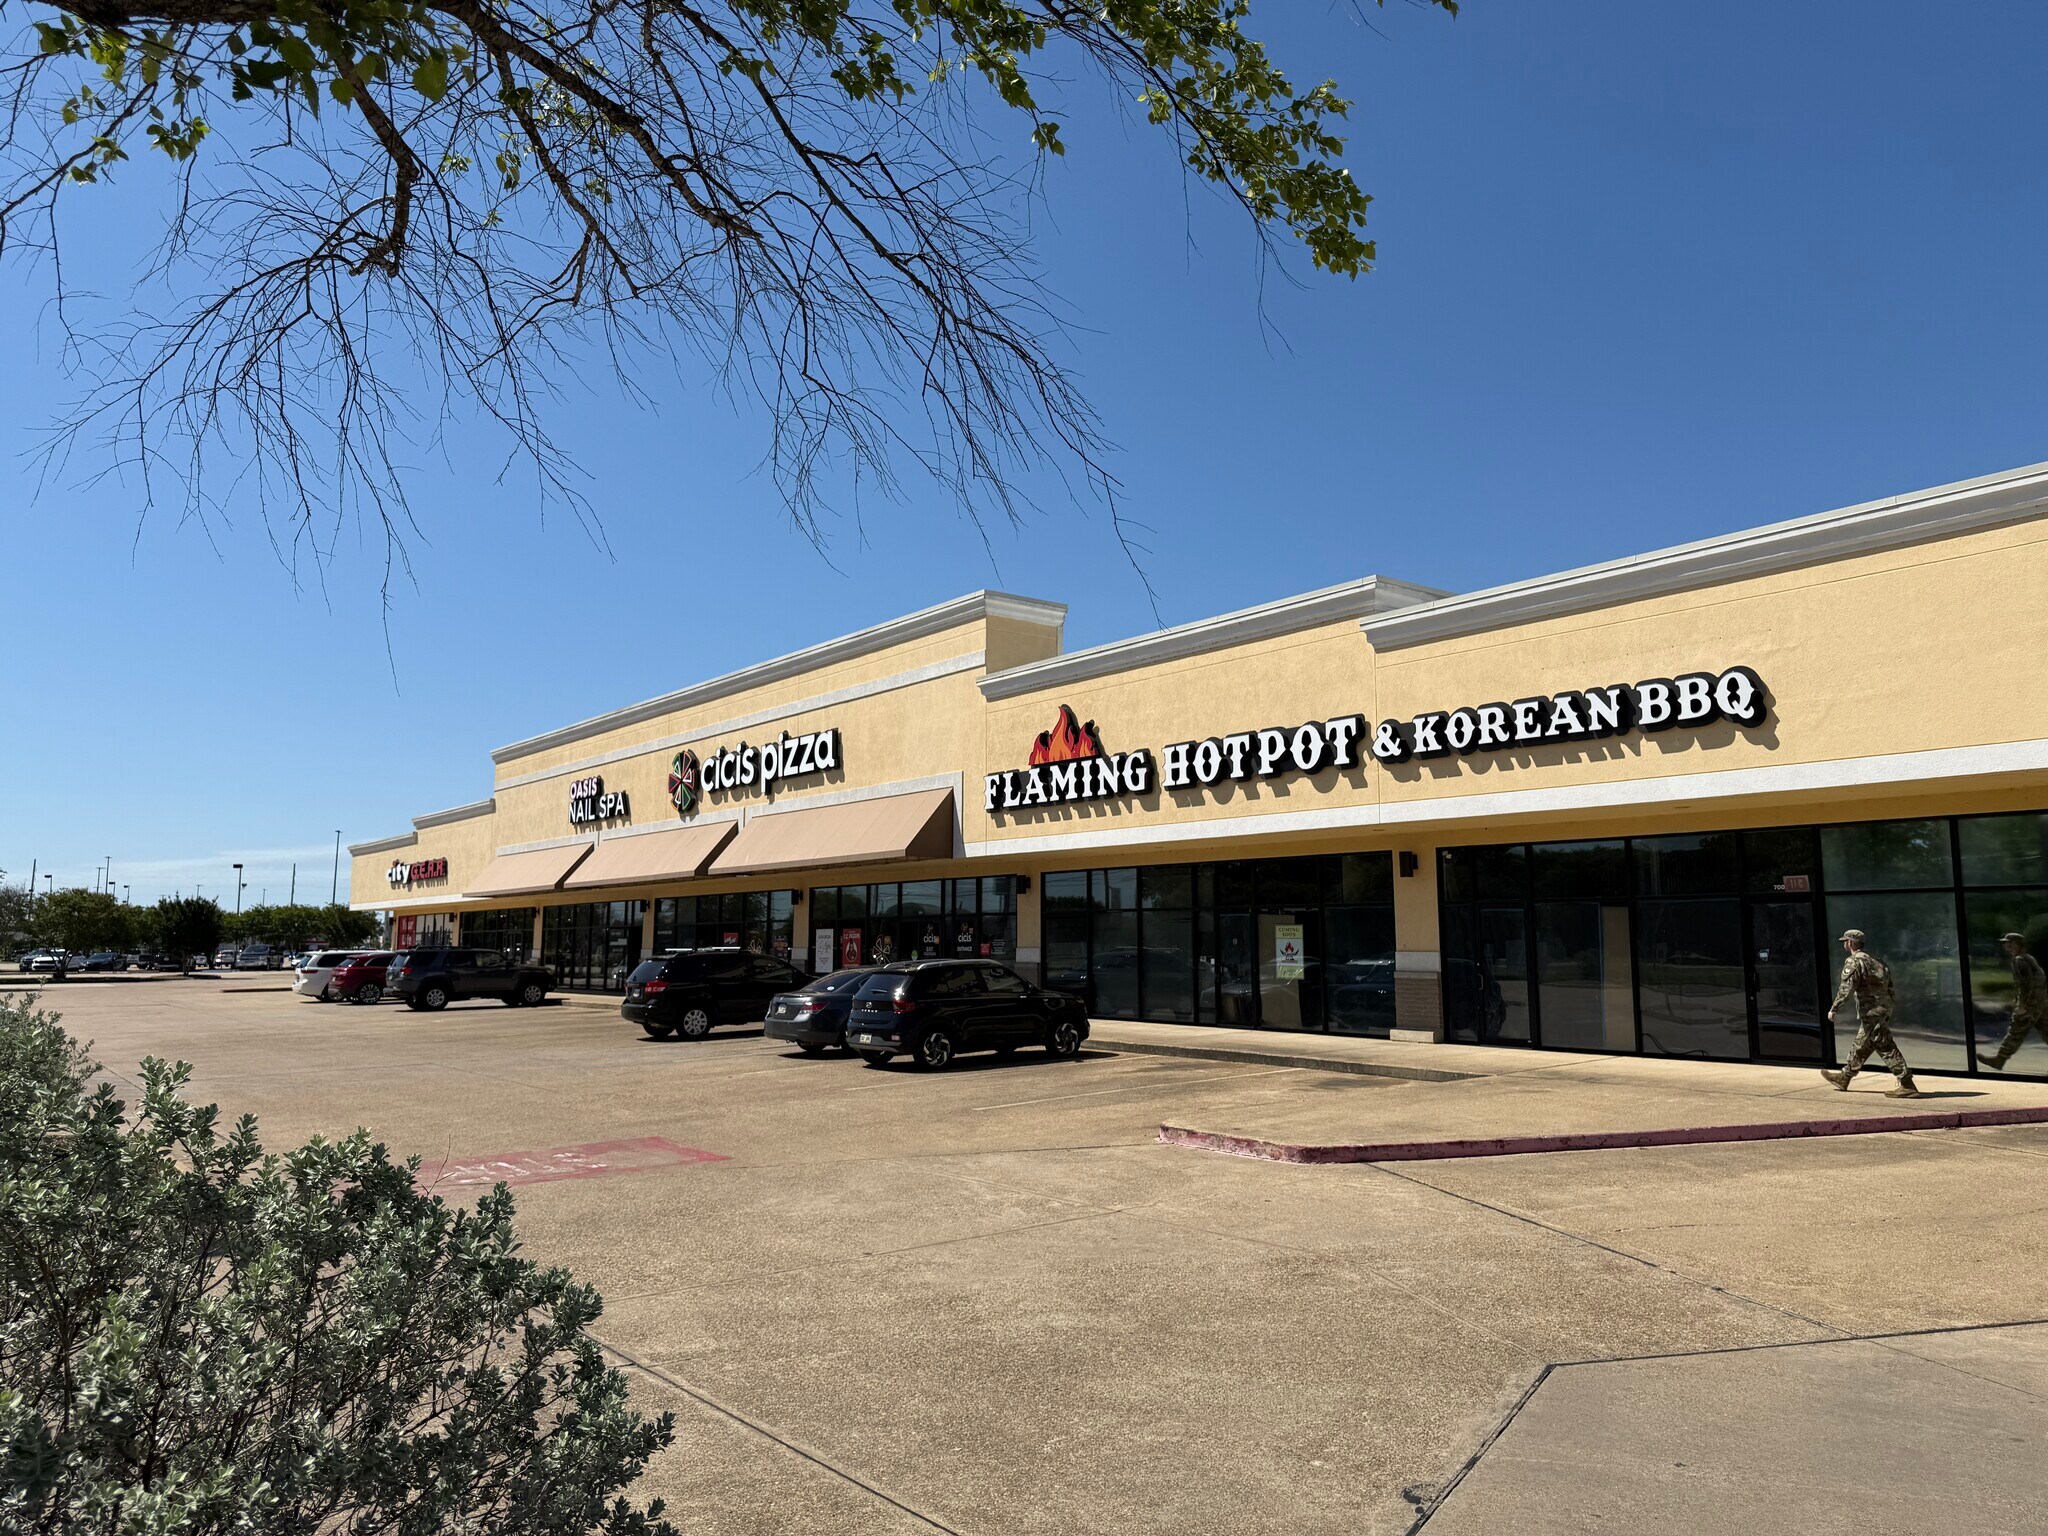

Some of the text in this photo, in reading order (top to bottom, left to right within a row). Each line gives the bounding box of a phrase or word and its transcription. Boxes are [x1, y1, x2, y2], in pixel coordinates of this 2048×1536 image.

[984, 671, 1755, 810] FLAMING HOTPOT & KOREAN BBQ
[700, 730, 835, 793] cicis pizza
[570, 777, 598, 800] OASIS
[569, 792, 625, 823] NAIL SPA
[957, 933, 972, 943] cicis
